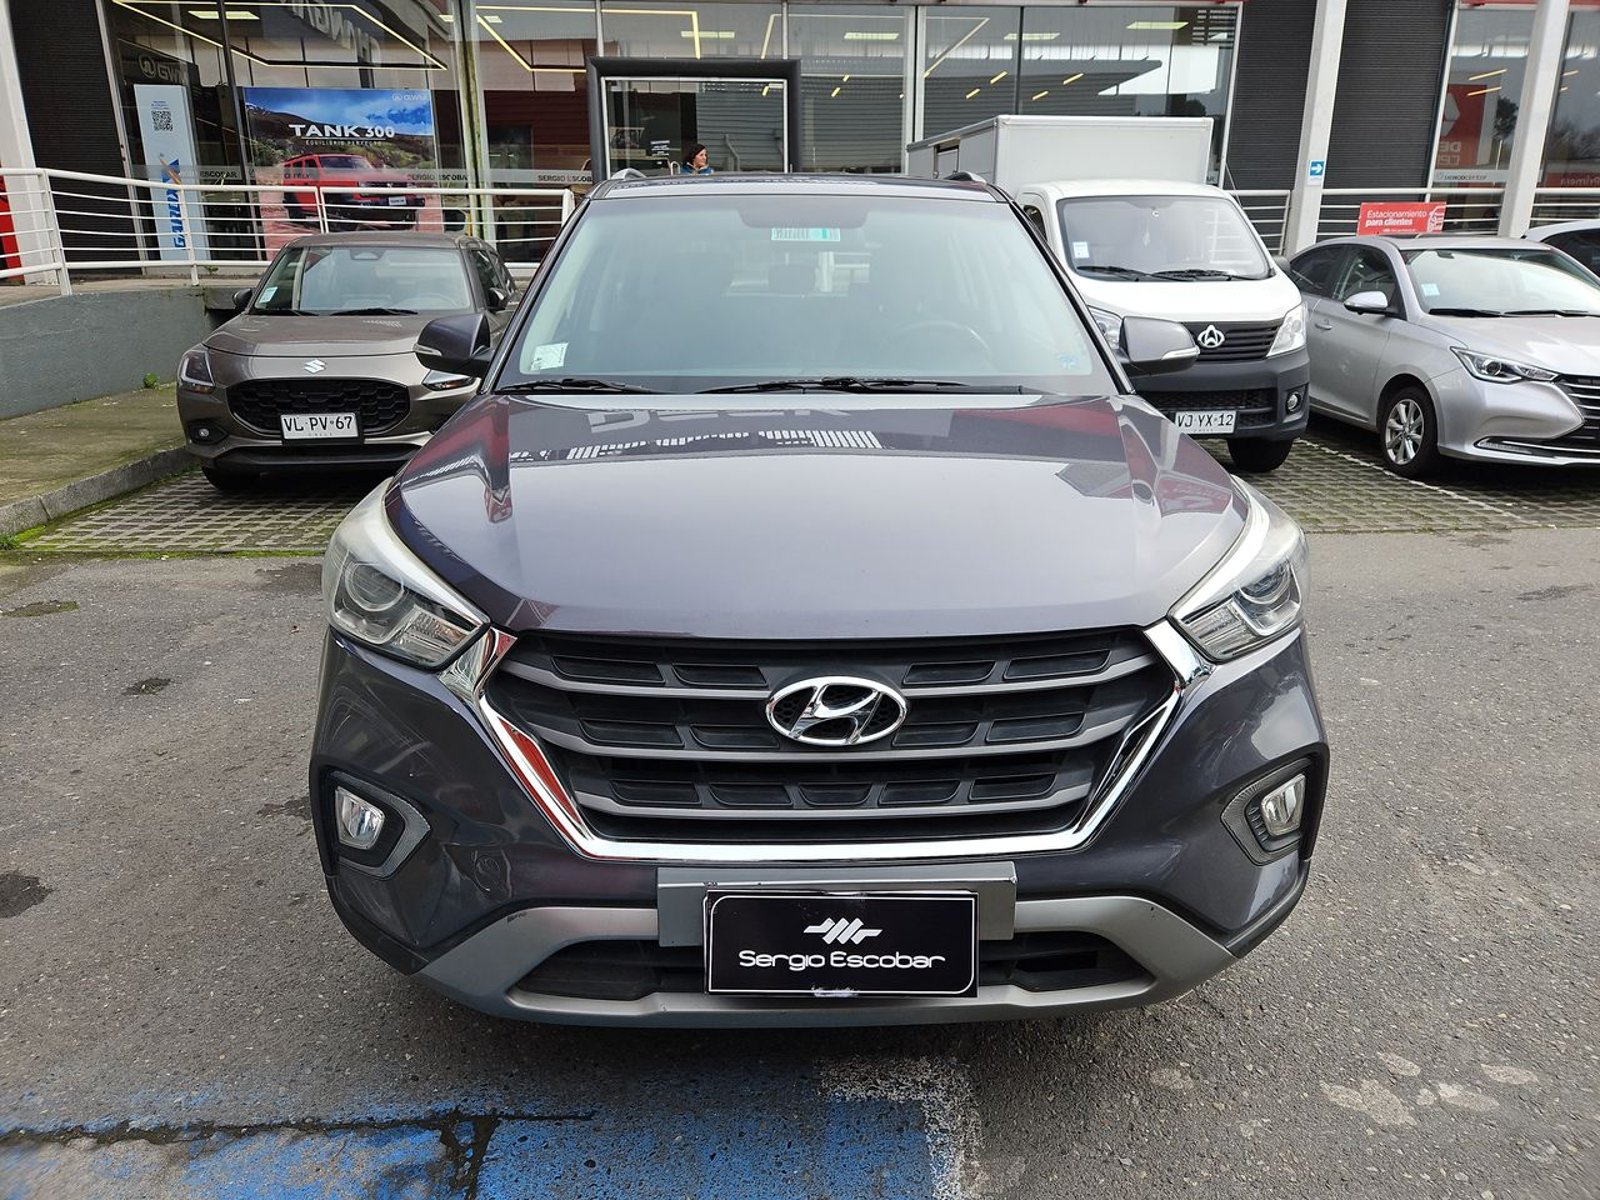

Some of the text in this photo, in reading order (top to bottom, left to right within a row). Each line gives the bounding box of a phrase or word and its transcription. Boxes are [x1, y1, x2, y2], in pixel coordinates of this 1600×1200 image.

[288, 124, 396, 138] TANK 300
[537, 174, 566, 182] SERGIO
[1367, 210, 1427, 219] Estacionamiento
[1365, 218, 1413, 227] para clientes
[738, 950, 946, 972] Sergio Escobar
